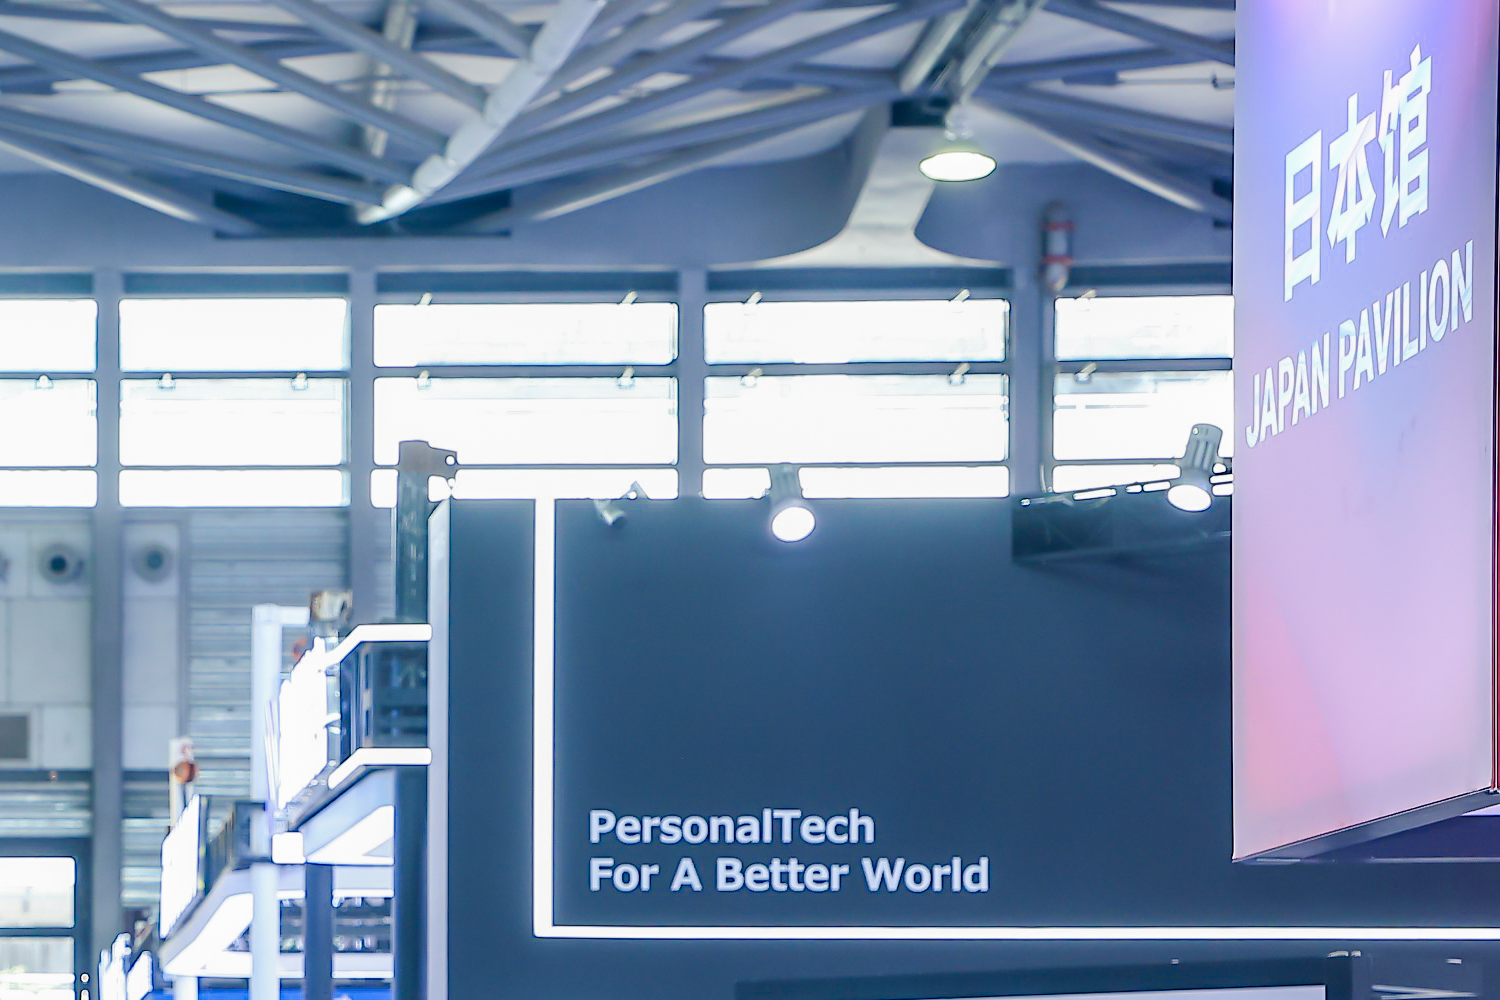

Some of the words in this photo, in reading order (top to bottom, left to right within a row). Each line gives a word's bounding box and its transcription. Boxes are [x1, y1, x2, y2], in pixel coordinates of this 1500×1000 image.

[1284, 43, 1432, 302] 日本馆
[1246, 331, 1329, 449] JAPAN
[1338, 239, 1473, 399] PAVILION
[589, 808, 876, 844] PersonalTech
[589, 857, 659, 891] For
[670, 857, 703, 892] A
[716, 857, 850, 892] Better
[861, 856, 990, 893] World
